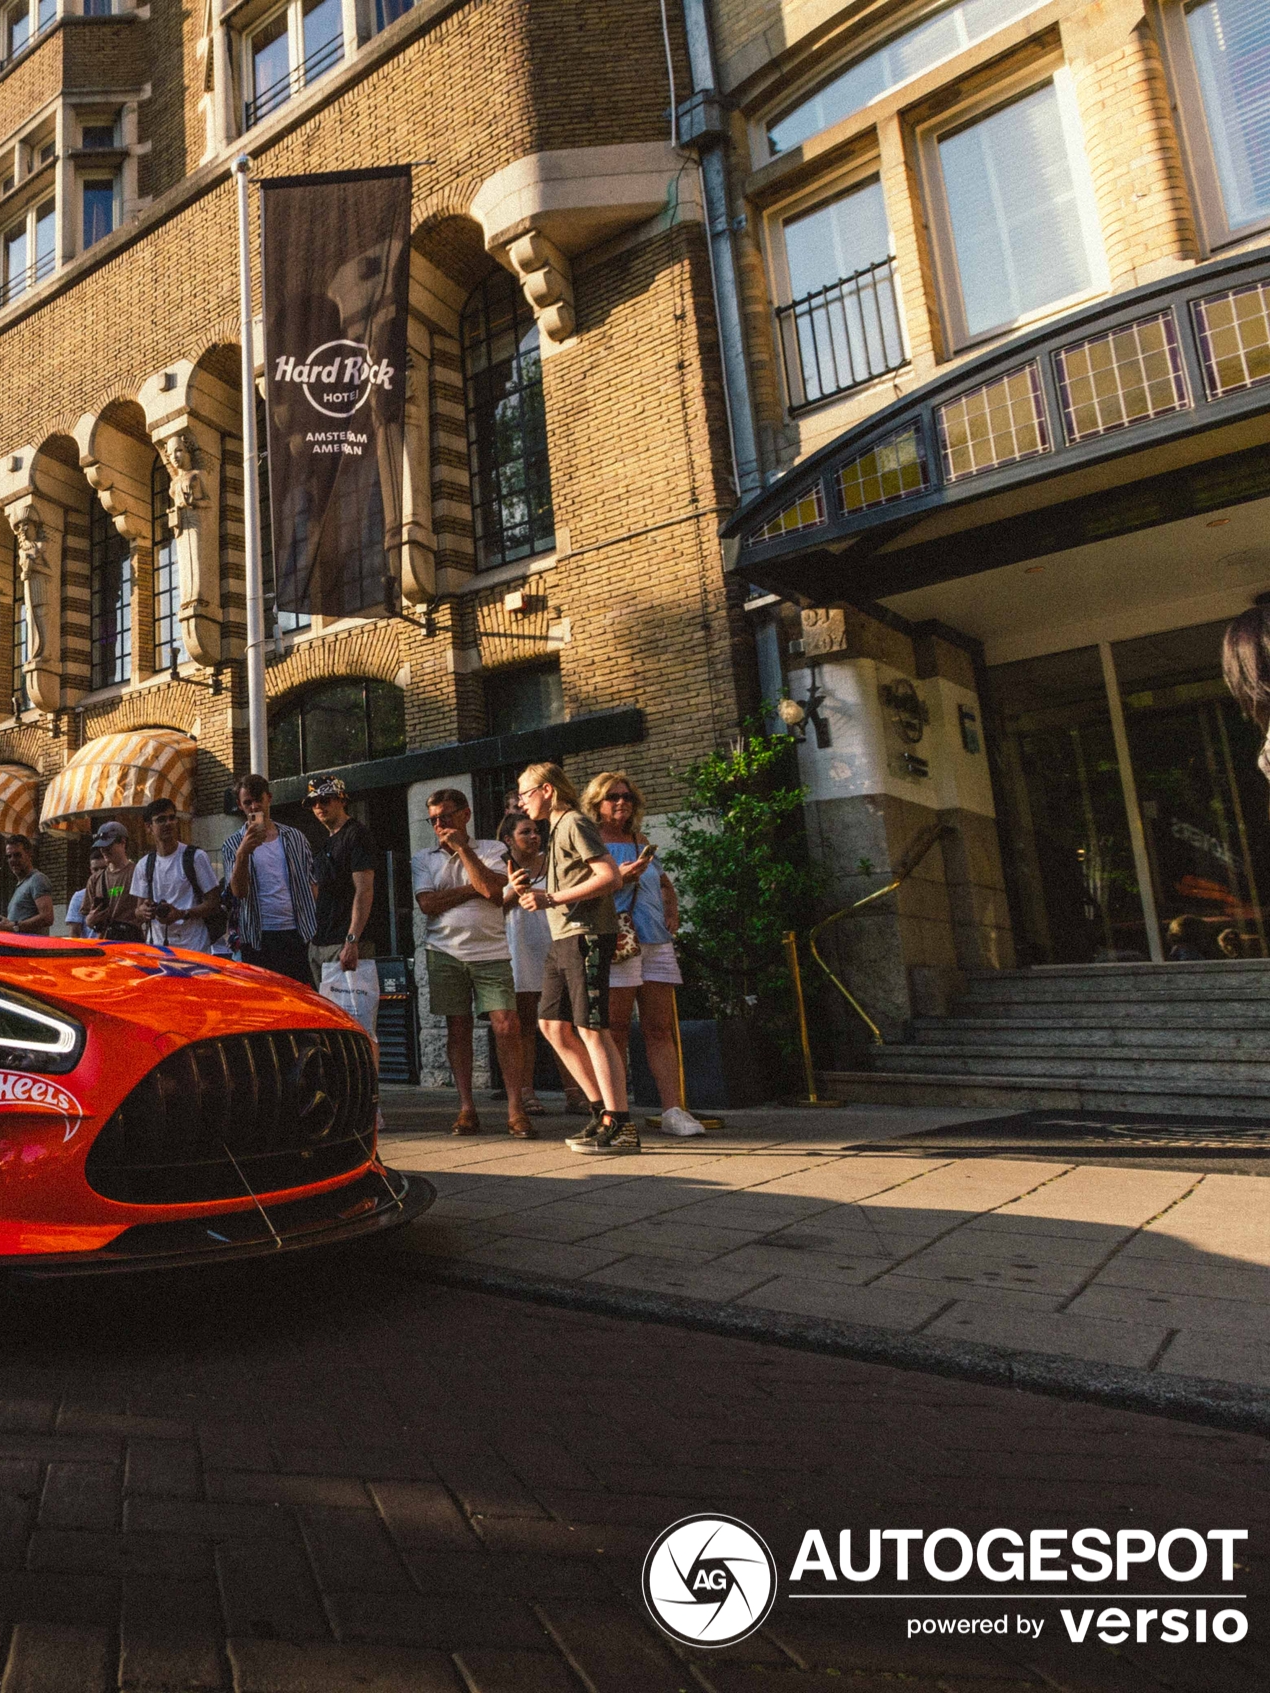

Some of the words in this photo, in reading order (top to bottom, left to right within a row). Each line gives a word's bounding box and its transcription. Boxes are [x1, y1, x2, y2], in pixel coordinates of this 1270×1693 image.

[274, 355, 341, 383] Hard
[343, 355, 395, 390] Rock
[305, 431, 368, 443] AMSTERAM
